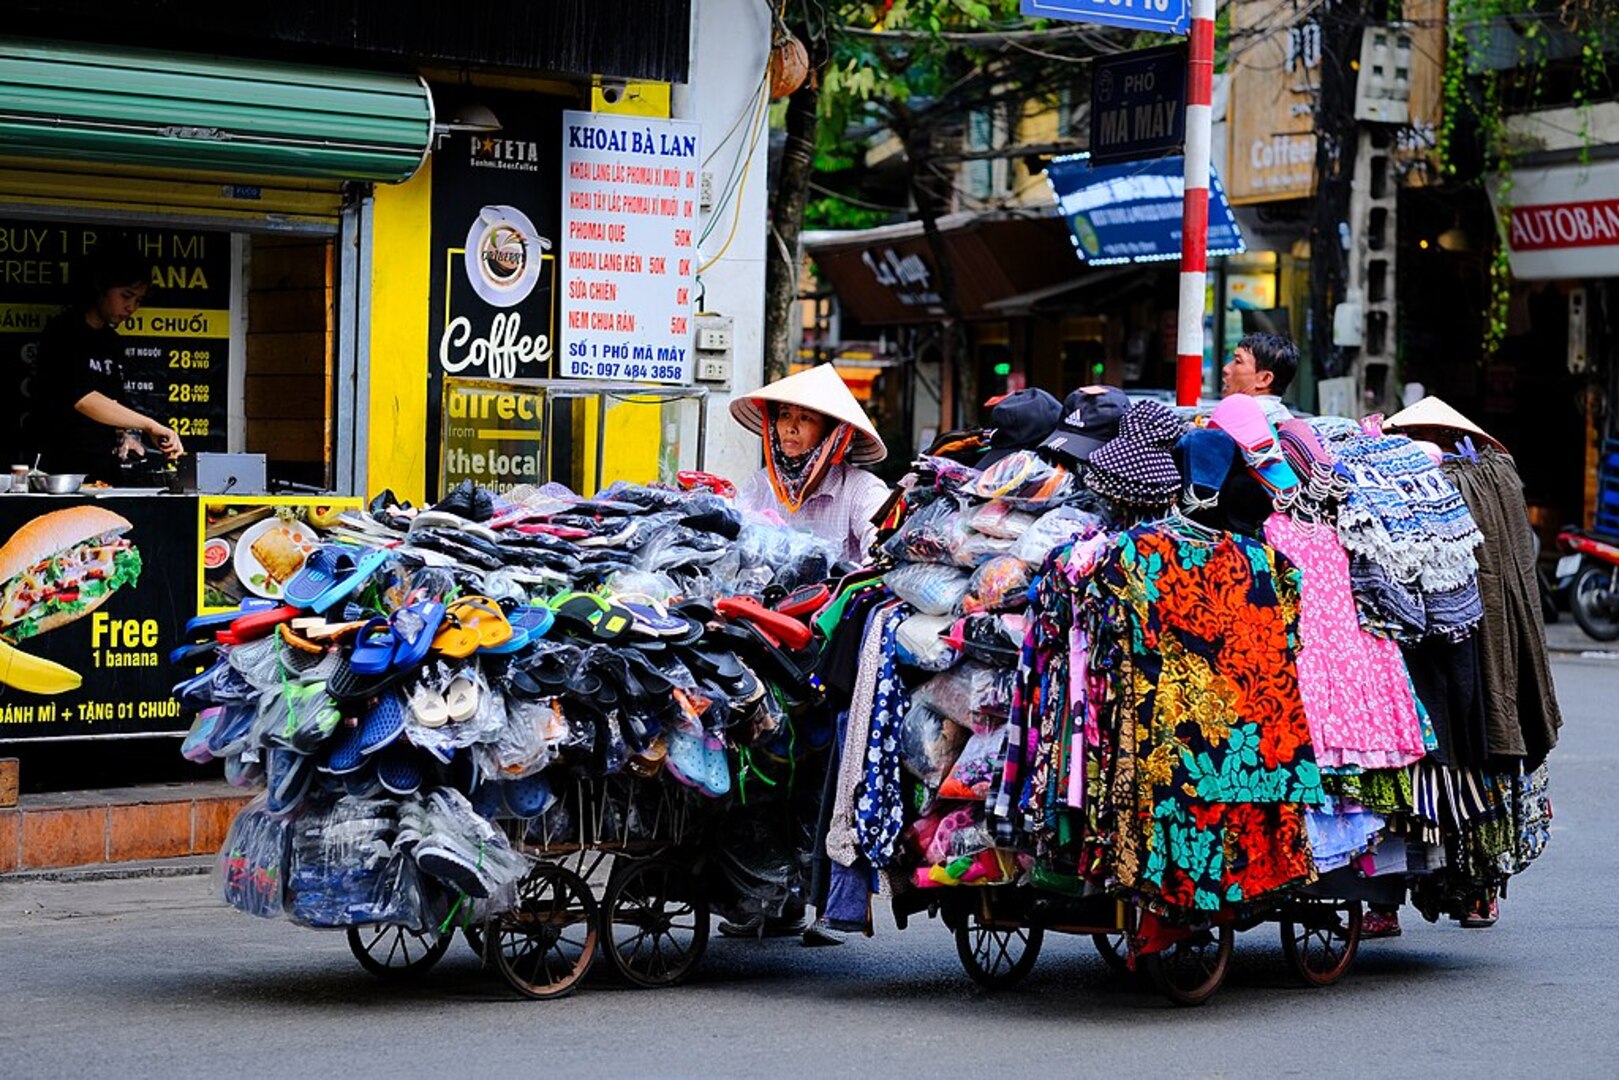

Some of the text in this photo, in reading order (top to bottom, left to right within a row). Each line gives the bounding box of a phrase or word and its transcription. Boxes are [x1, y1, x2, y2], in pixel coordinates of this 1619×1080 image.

[1124, 63, 1155, 94] PHỐ
[1135, 94, 1177, 140] MÂY
[568, 126, 696, 157] KHOAI BÀ LAN
[570, 161, 591, 179] KHOAI
[593, 163, 611, 182] LANG
[570, 191, 591, 210] KHOAI
[60, 231, 68, 254] 1
[569, 221, 692, 247] PHOMAI QUE 50K
[59, 263, 69, 284] 1
[569, 251, 596, 270] KHOAI
[599, 252, 622, 271] LANG
[649, 256, 666, 274] 50K
[0, 311, 208, 332] ÁNH 01 CHUỐI
[569, 311, 589, 329] NEM
[591, 312, 614, 331] CHUA
[671, 317, 687, 335] 50K
[440, 312, 553, 379] Coffee
[569, 338, 686, 362] SỐ 1 PHỐ MÃ MÂY
[597, 362, 620, 377] 097
[624, 364, 648, 378] 484
[651, 365, 682, 380] 3858
[448, 448, 485, 474] the
[92, 612, 159, 648] Free
[93, 650, 158, 667] 1 banana
[38, 701, 56, 722] MÌ
[78, 701, 114, 724] TẶNG
[118, 702, 133, 718] 01
